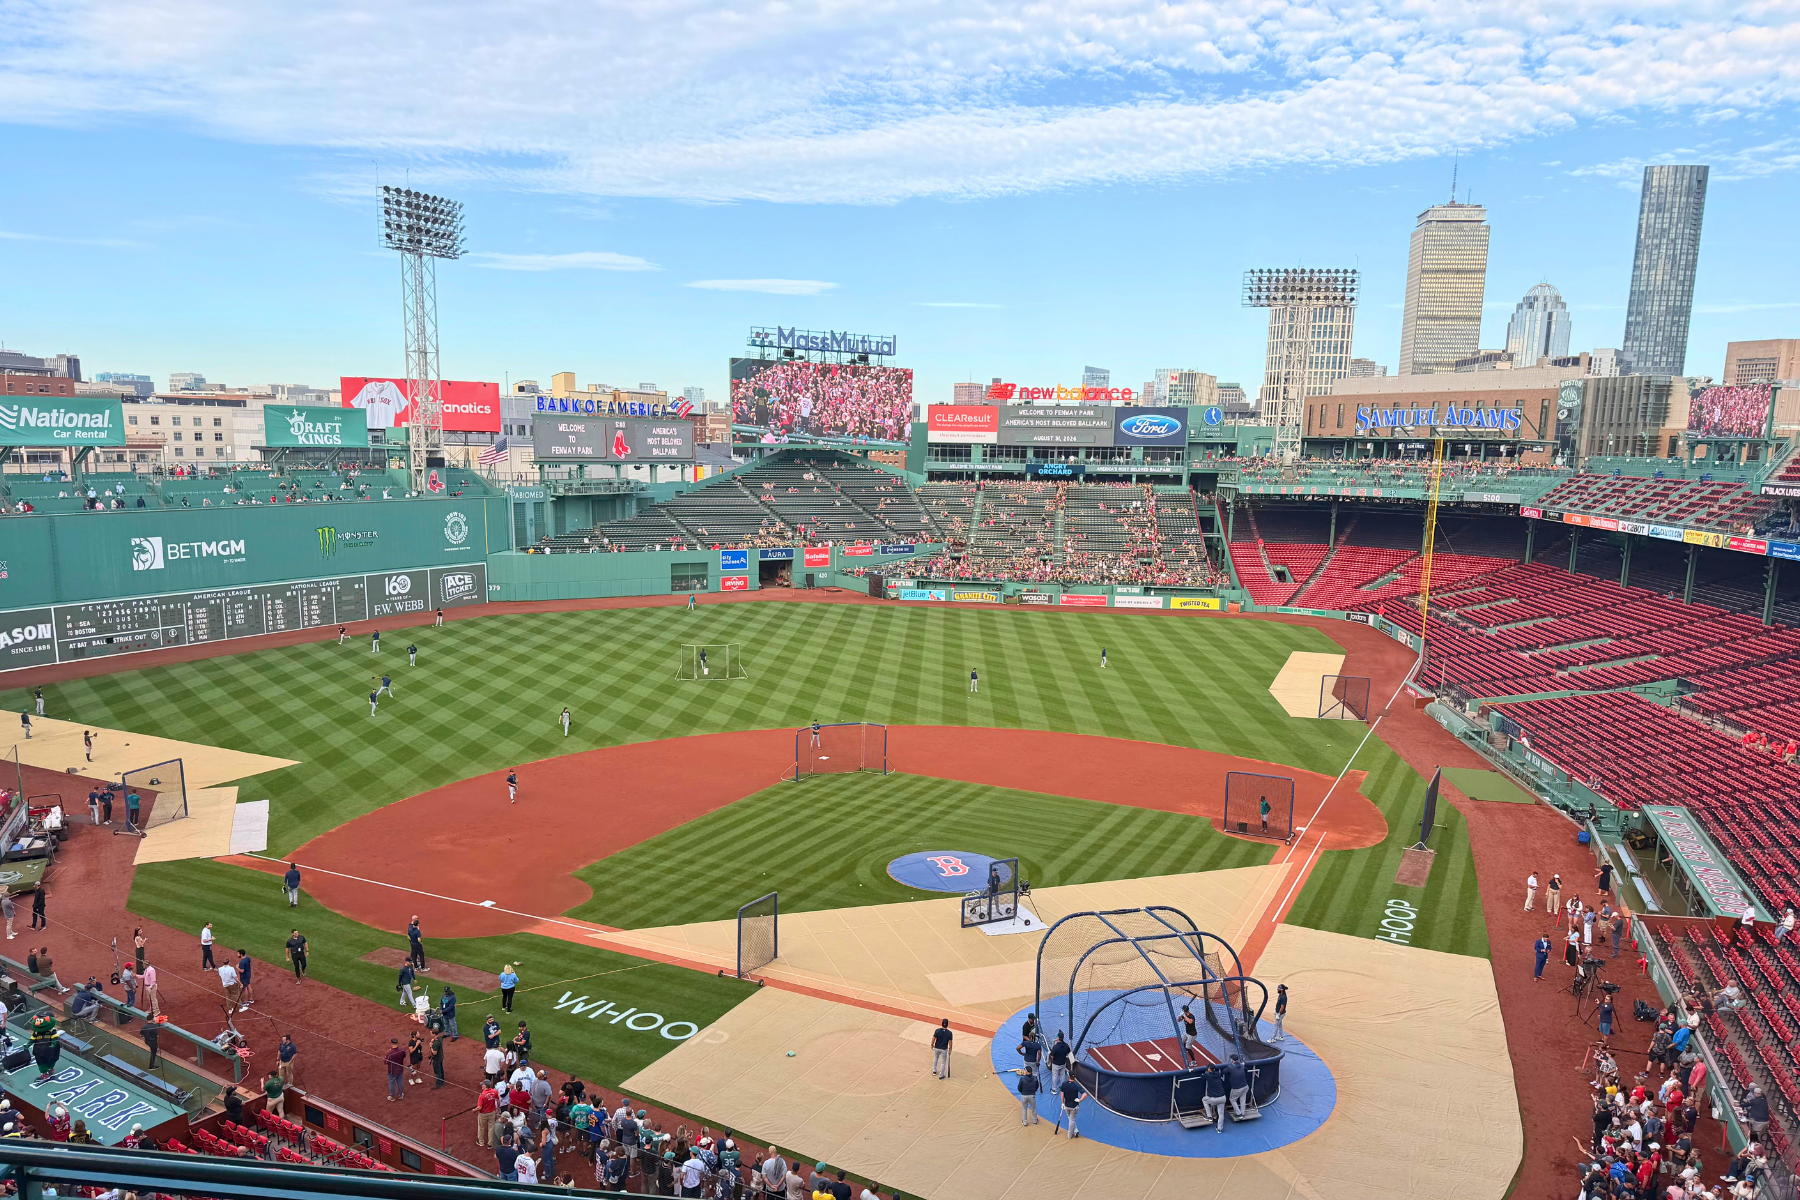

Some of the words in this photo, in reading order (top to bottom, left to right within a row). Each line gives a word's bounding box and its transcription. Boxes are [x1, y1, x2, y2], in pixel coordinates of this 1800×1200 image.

[777, 325, 897, 356] MassMutual
[1560, 380, 1584, 388] BOSTON
[1020, 386, 1055, 400] new
[1056, 382, 1132, 400] balance
[380, 397, 392, 406] SOX
[1558, 398, 1580, 408] ACADEMY
[537, 396, 581, 413] BANK
[585, 400, 602, 414] OF
[607, 401, 668, 418] AMERICA
[934, 413, 991, 423] CLEAResult
[1356, 406, 1440, 431] SAMUEL
[1442, 405, 1521, 430] ADAMS
[290, 421, 342, 434] DRAFT
[558, 423, 585, 432] WELCOME
[1132, 417, 1168, 434] Ford
[53, 430, 72, 438] Car
[74, 429, 108, 438] Rental
[652, 427, 678, 435] AMERICA'S
[298, 433, 342, 445] KINGS
[661, 438, 682, 446] BELOVED
[551, 446, 576, 454] FENWAY
[578, 446, 593, 455] PARK
[652, 447, 678, 456] BALLPARK
[1769, 487, 1785, 495] BLACK
[1786, 488, 1800, 496] LIVES
[337, 531, 379, 541] MONSTER
[166, 539, 246, 560] BETMGM
[385, 575, 411, 595] 160
[447, 575, 473, 588] ACE
[448, 584, 473, 596] TICKET
[902, 590, 926, 599] jetBlue
[193, 592, 225, 600] AMERICAN
[954, 592, 982, 600] GRANITE
[983, 593, 997, 602] CITY
[82, 602, 124, 612] FENWAY
[394, 599, 424, 612] WEBB
[75, 627, 96, 636] BOSTON
[11, 646, 34, 654] SINCE
[926, 855, 970, 877] B
[1374, 898, 1418, 944] HOOP
[29, 1066, 158, 1131] PARK
